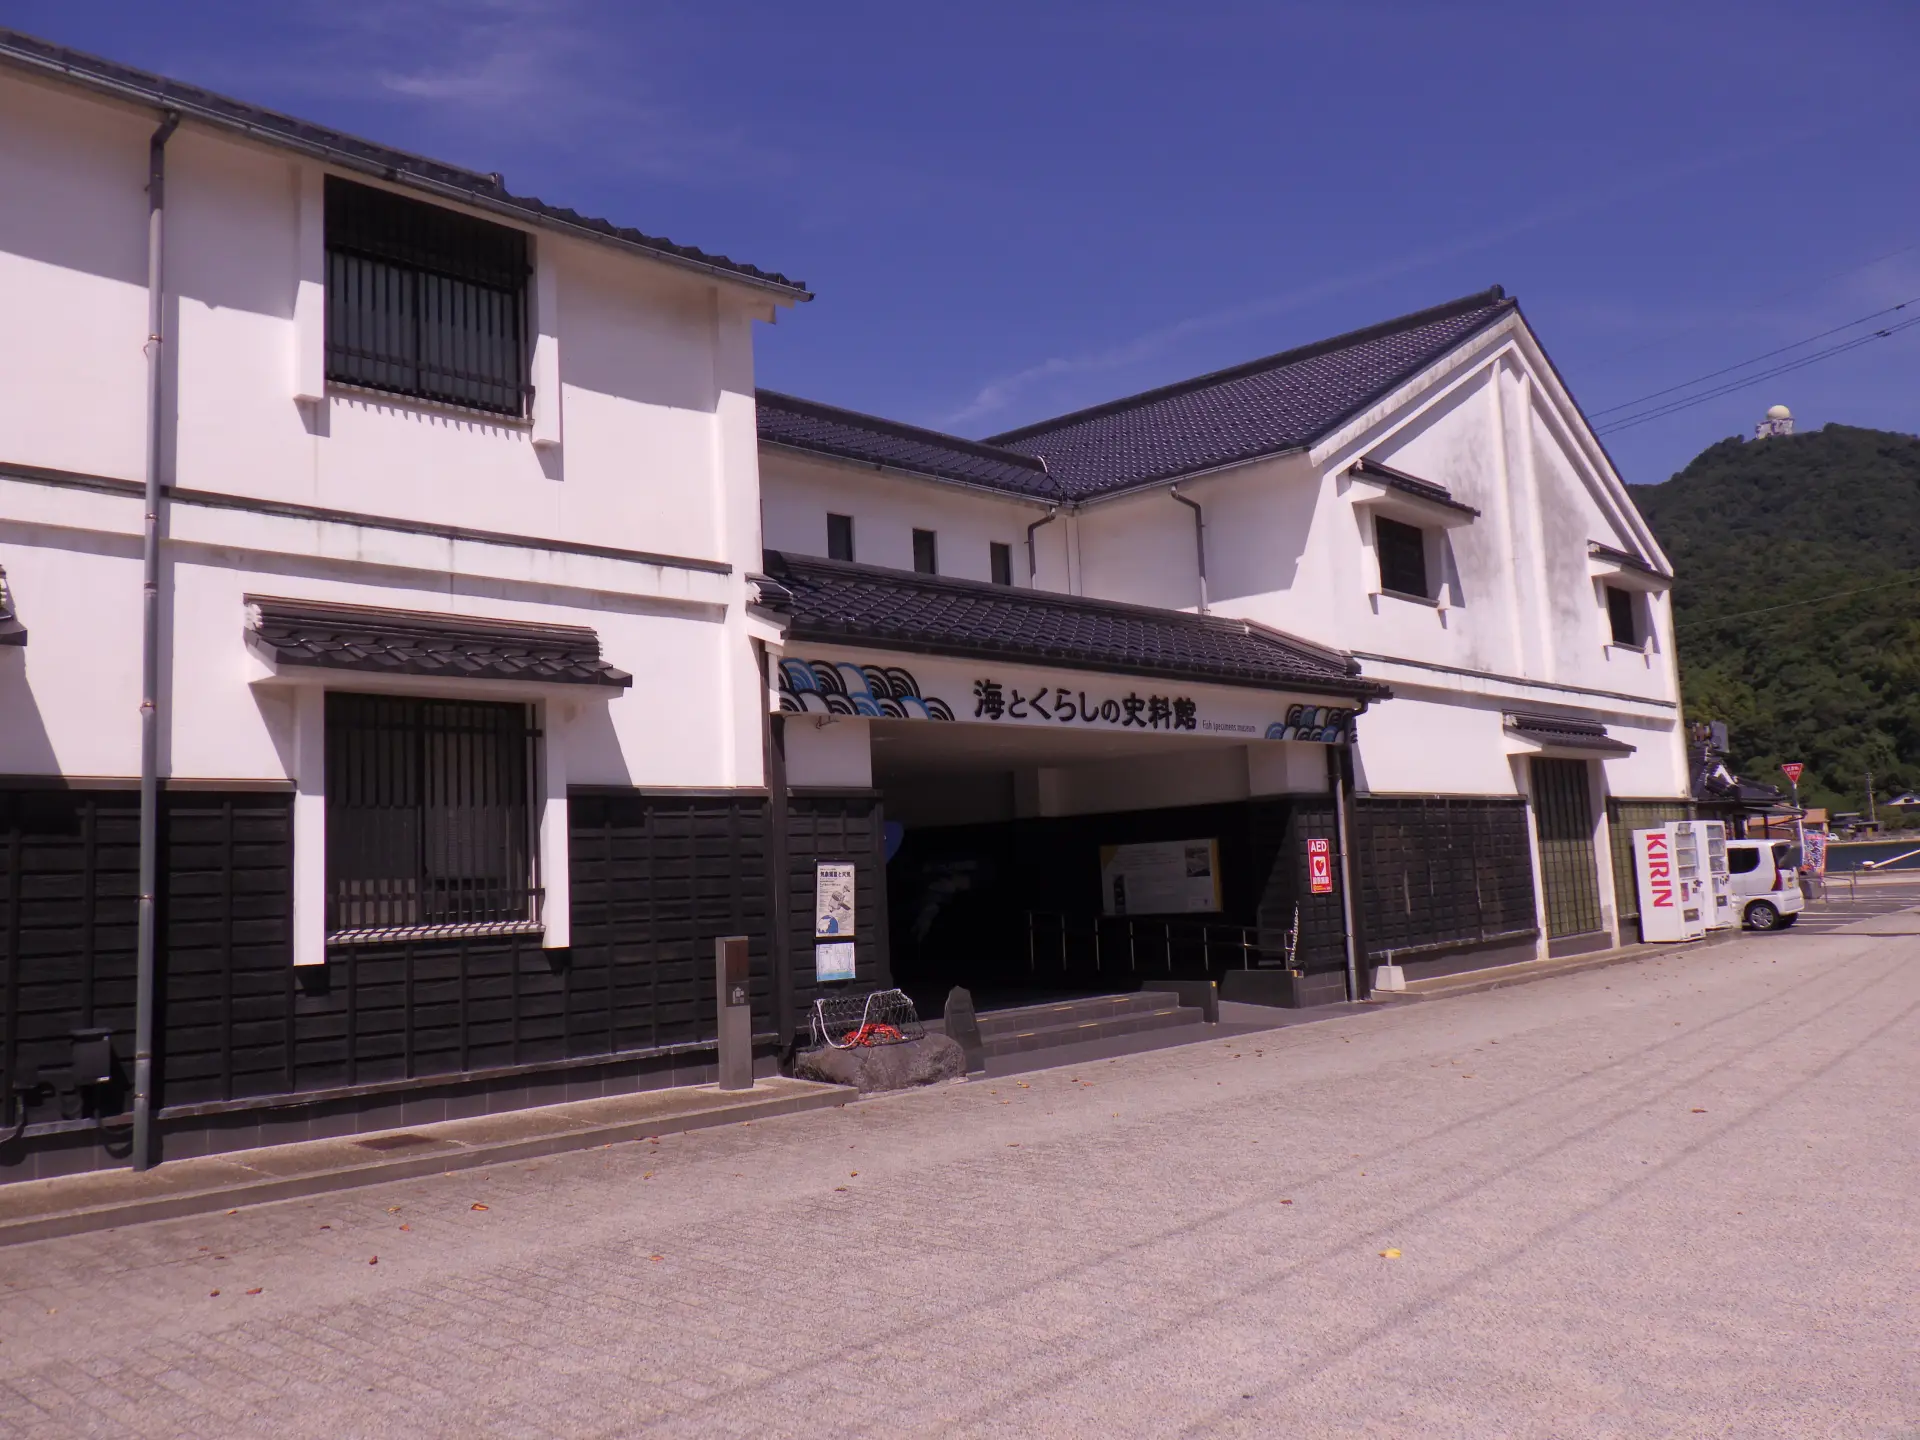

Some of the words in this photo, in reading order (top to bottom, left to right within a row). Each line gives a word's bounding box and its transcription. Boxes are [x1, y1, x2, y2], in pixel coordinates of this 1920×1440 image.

[973, 678, 1197, 730] 海とくらしの史料館
[1310, 840, 1327, 853] AED
[1646, 833, 1674, 907] KIRIN
